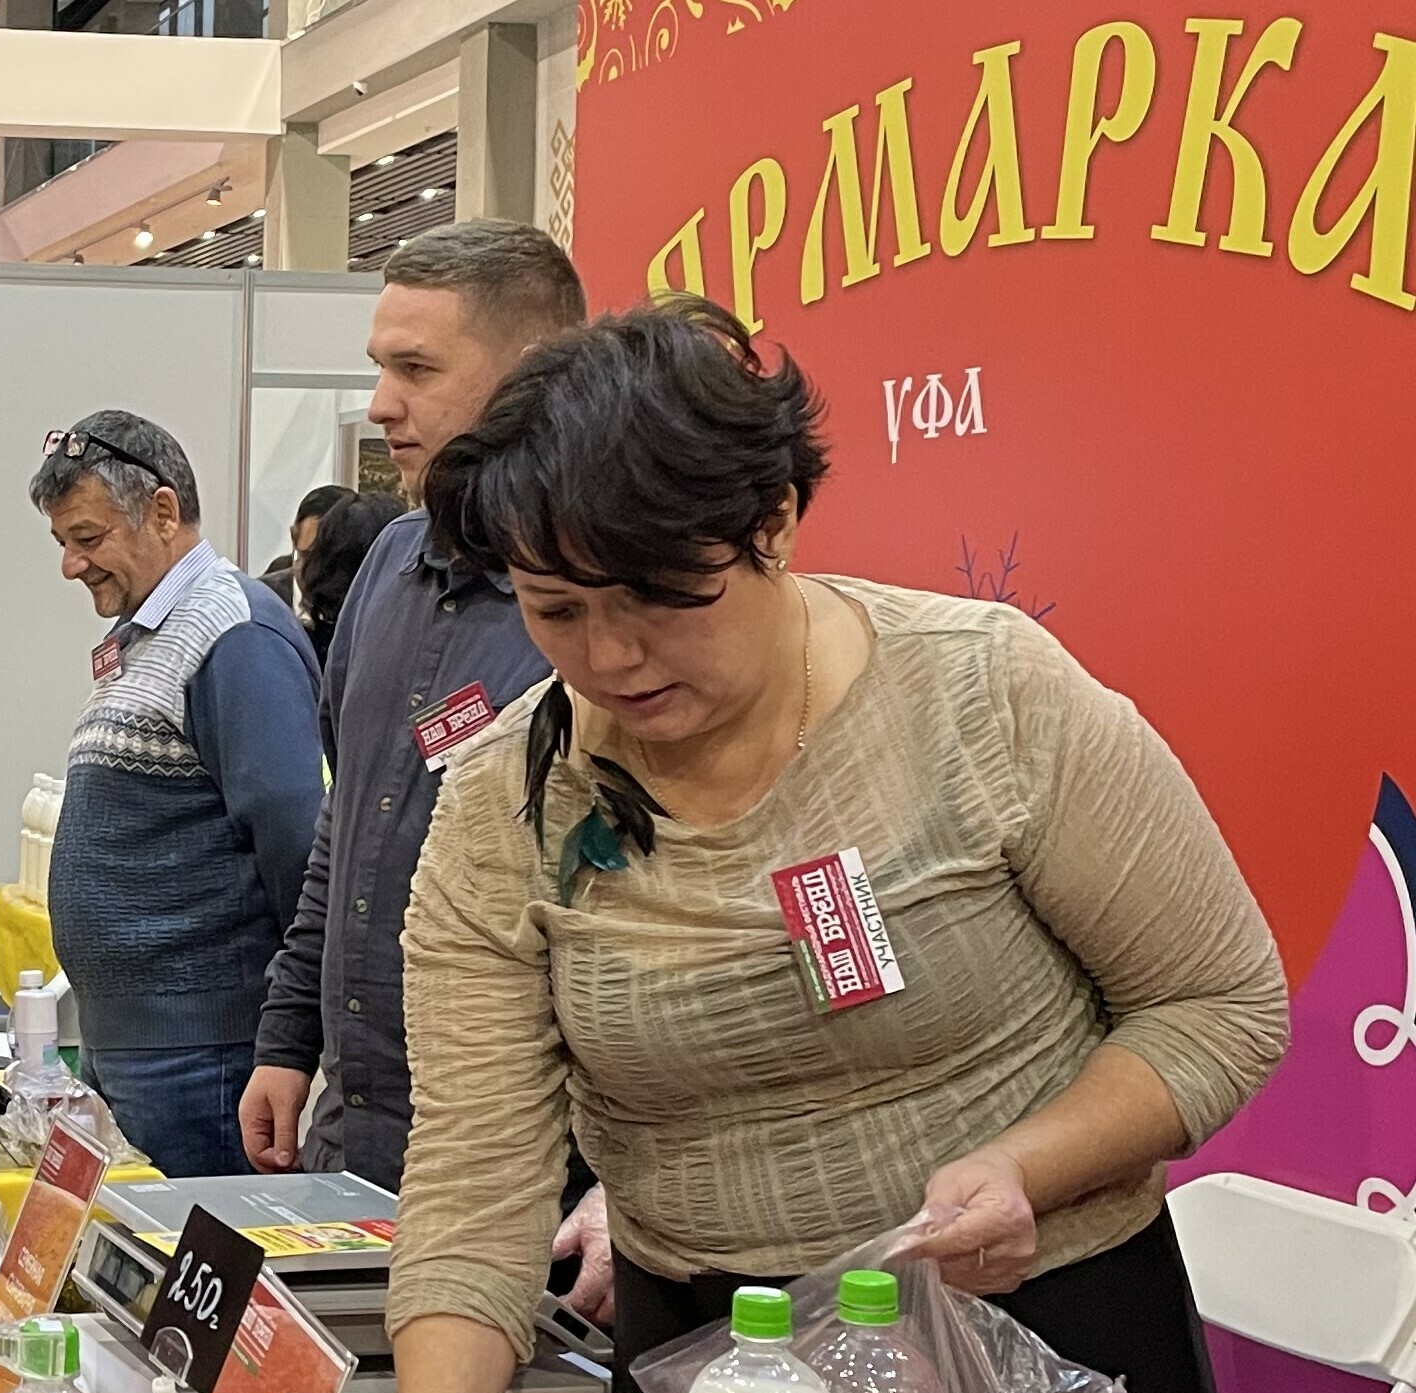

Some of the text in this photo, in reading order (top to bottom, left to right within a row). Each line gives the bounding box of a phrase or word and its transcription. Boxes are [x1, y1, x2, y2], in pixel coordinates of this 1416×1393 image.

[647, 17, 1416, 338] ЯРМАРКА
[883, 366, 988, 463] УФА
[801, 867, 847, 945] БРЕНД
[850, 872, 895, 970] УЧАСТНИК
